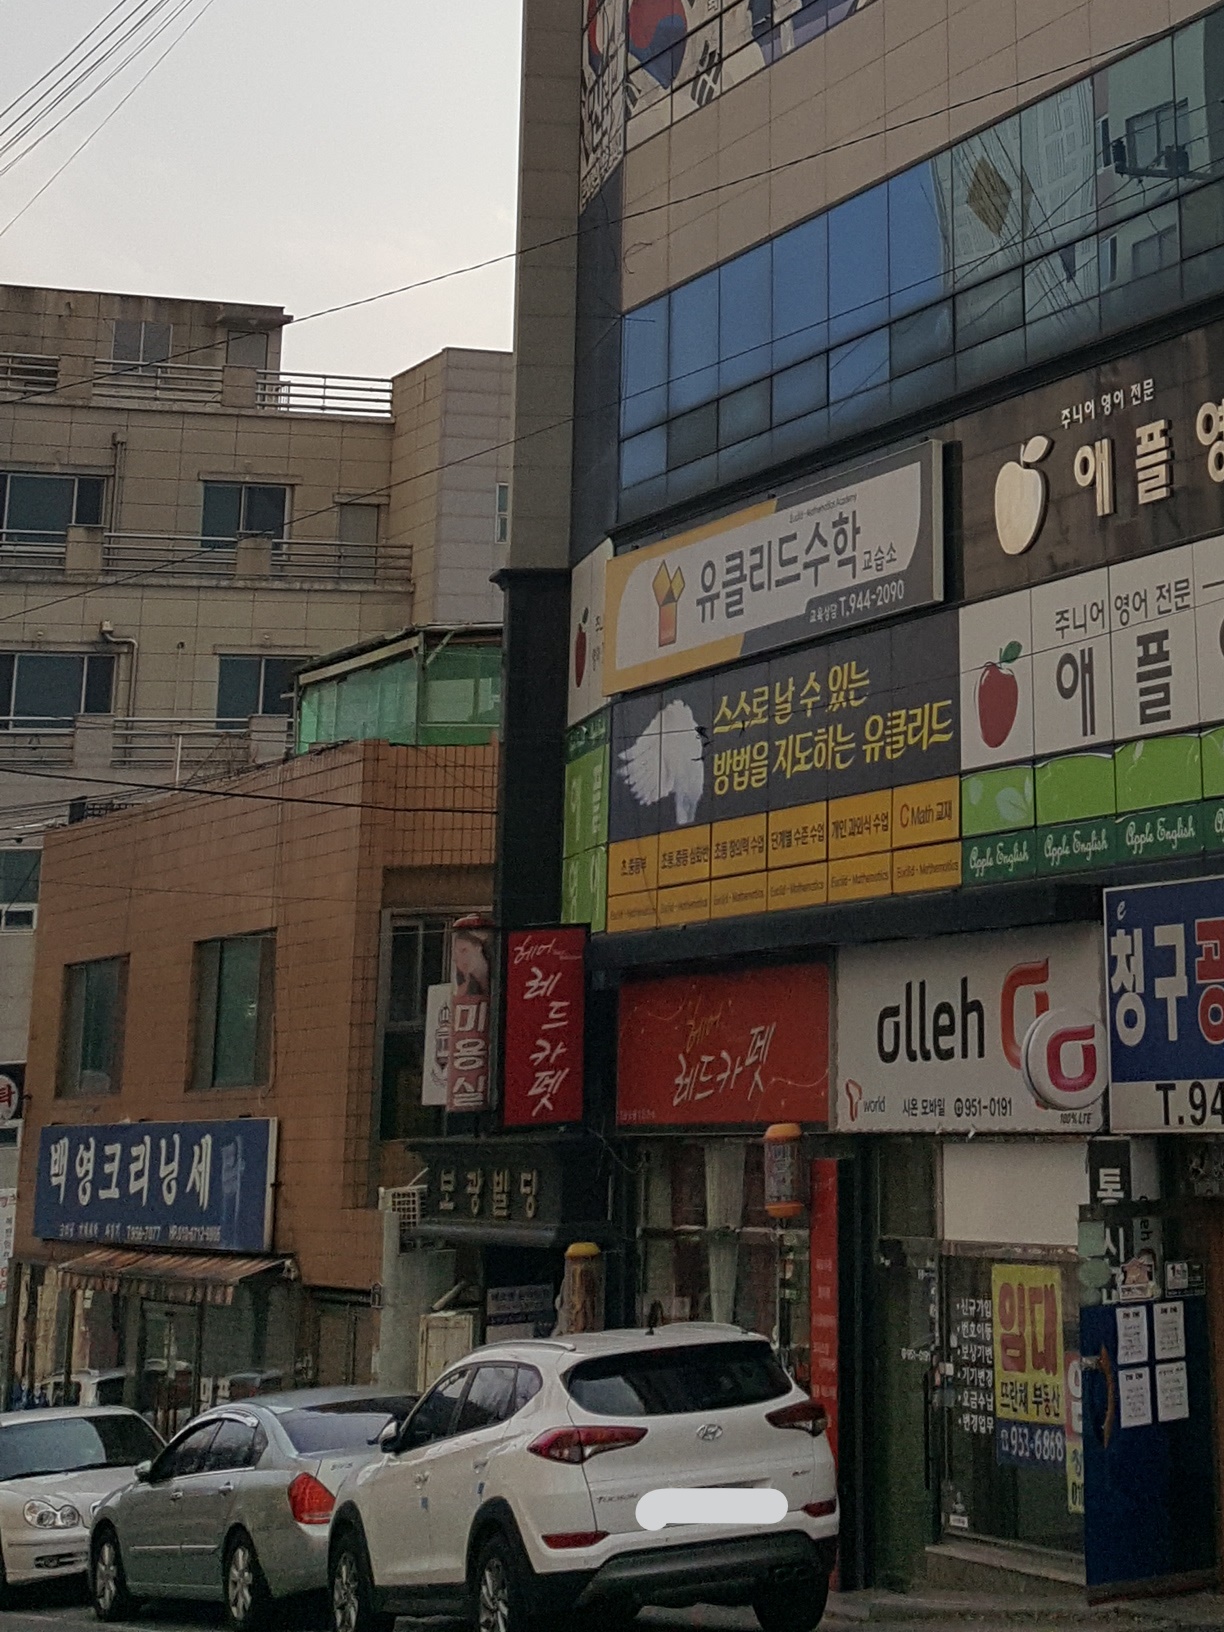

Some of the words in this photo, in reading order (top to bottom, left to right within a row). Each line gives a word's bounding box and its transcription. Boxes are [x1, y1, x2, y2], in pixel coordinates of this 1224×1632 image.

[1061, 397, 1096, 430] 주니어
[1100, 390, 1126, 418] 영어
[1130, 378, 1155, 407] 전문
[696, 509, 861, 624] 유클리드수학
[862, 541, 898, 573] 교습소
[809, 604, 838, 624] 교육상담
[839, 578, 905, 617] T.944-2090
[1054, 594, 1107, 640] 주니어
[1113, 585, 1149, 627] 영어
[1155, 577, 1192, 617] 전문
[713, 685, 770, 735] 스스로
[774, 676, 796, 726] 날
[800, 670, 822, 718] 수
[827, 659, 871, 713] 있는
[713, 740, 770, 796] 방법을
[772, 720, 857, 780] 지도하는
[862, 698, 954, 764] 유클리드
[831, 818, 847, 841] 개인
[873, 810, 889, 834] 수업
[911, 805, 935, 828] Math
[936, 799, 953, 822] 교재
[969, 846, 995, 878] Apple
[996, 840, 1030, 873] English
[1043, 833, 1071, 866] Apple
[1072, 827, 1109, 862] English
[1125, 821, 1154, 854] Apple
[1156, 814, 1197, 849] English
[877, 975, 986, 1065] olleh
[1110, 922, 1189, 1048] 청구
[452, 1001, 489, 1107] 미용실
[522, 965, 572, 1118] 레드카펫
[672, 1021, 777, 1108] 레드카펫
[863, 1096, 886, 1114] world
[902, 1097, 920, 1118] 시온
[920, 1096, 946, 1118] 모바일
[965, 1097, 1013, 1118] 951-0191
[999, 1282, 1059, 1377] 임대
[1000, 1381, 1029, 1414] 뜨란채
[1031, 1382, 1061, 1418] 부동산
[1009, 1425, 1066, 1462] 953-6868
